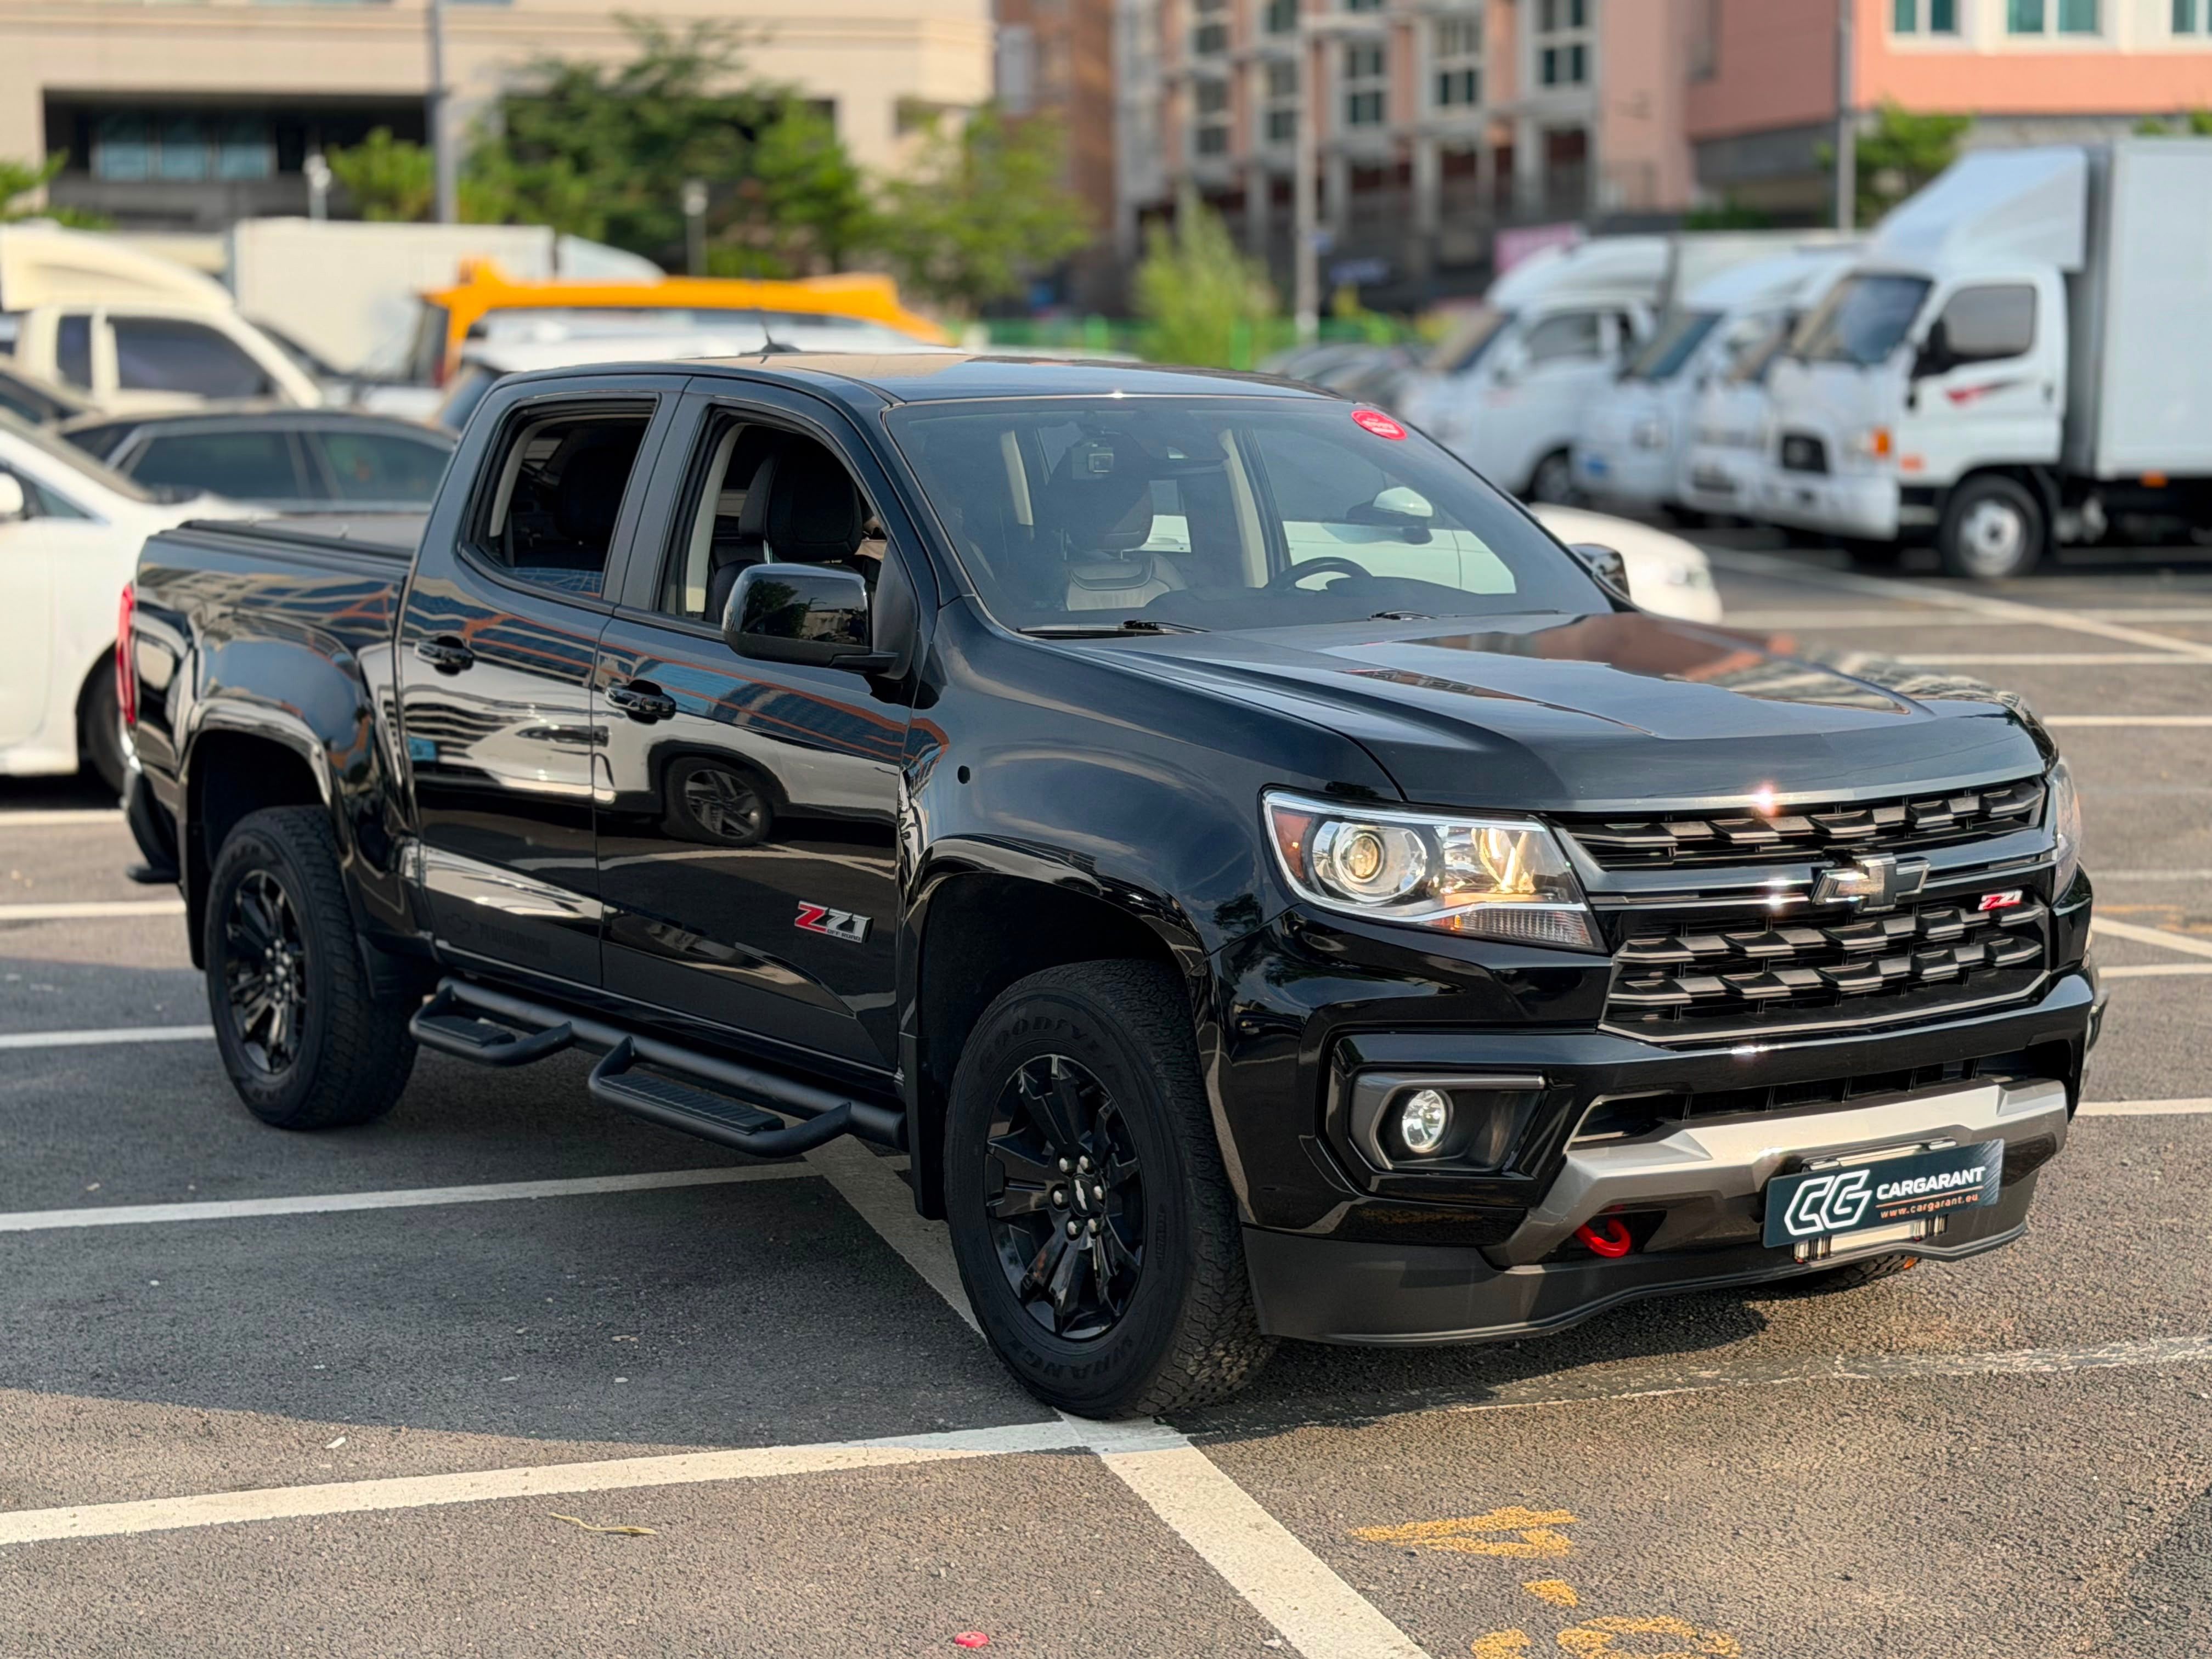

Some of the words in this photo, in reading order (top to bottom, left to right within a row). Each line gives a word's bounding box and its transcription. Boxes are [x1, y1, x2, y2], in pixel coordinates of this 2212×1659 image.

[794, 900, 872, 943] Z71
[842, 932, 861, 941] ROAD
[1876, 1166, 1986, 1200] CARGARANT
[1784, 1169, 1873, 1236] CG
[1881, 1194, 1979, 1219] www.cargarant.eu
